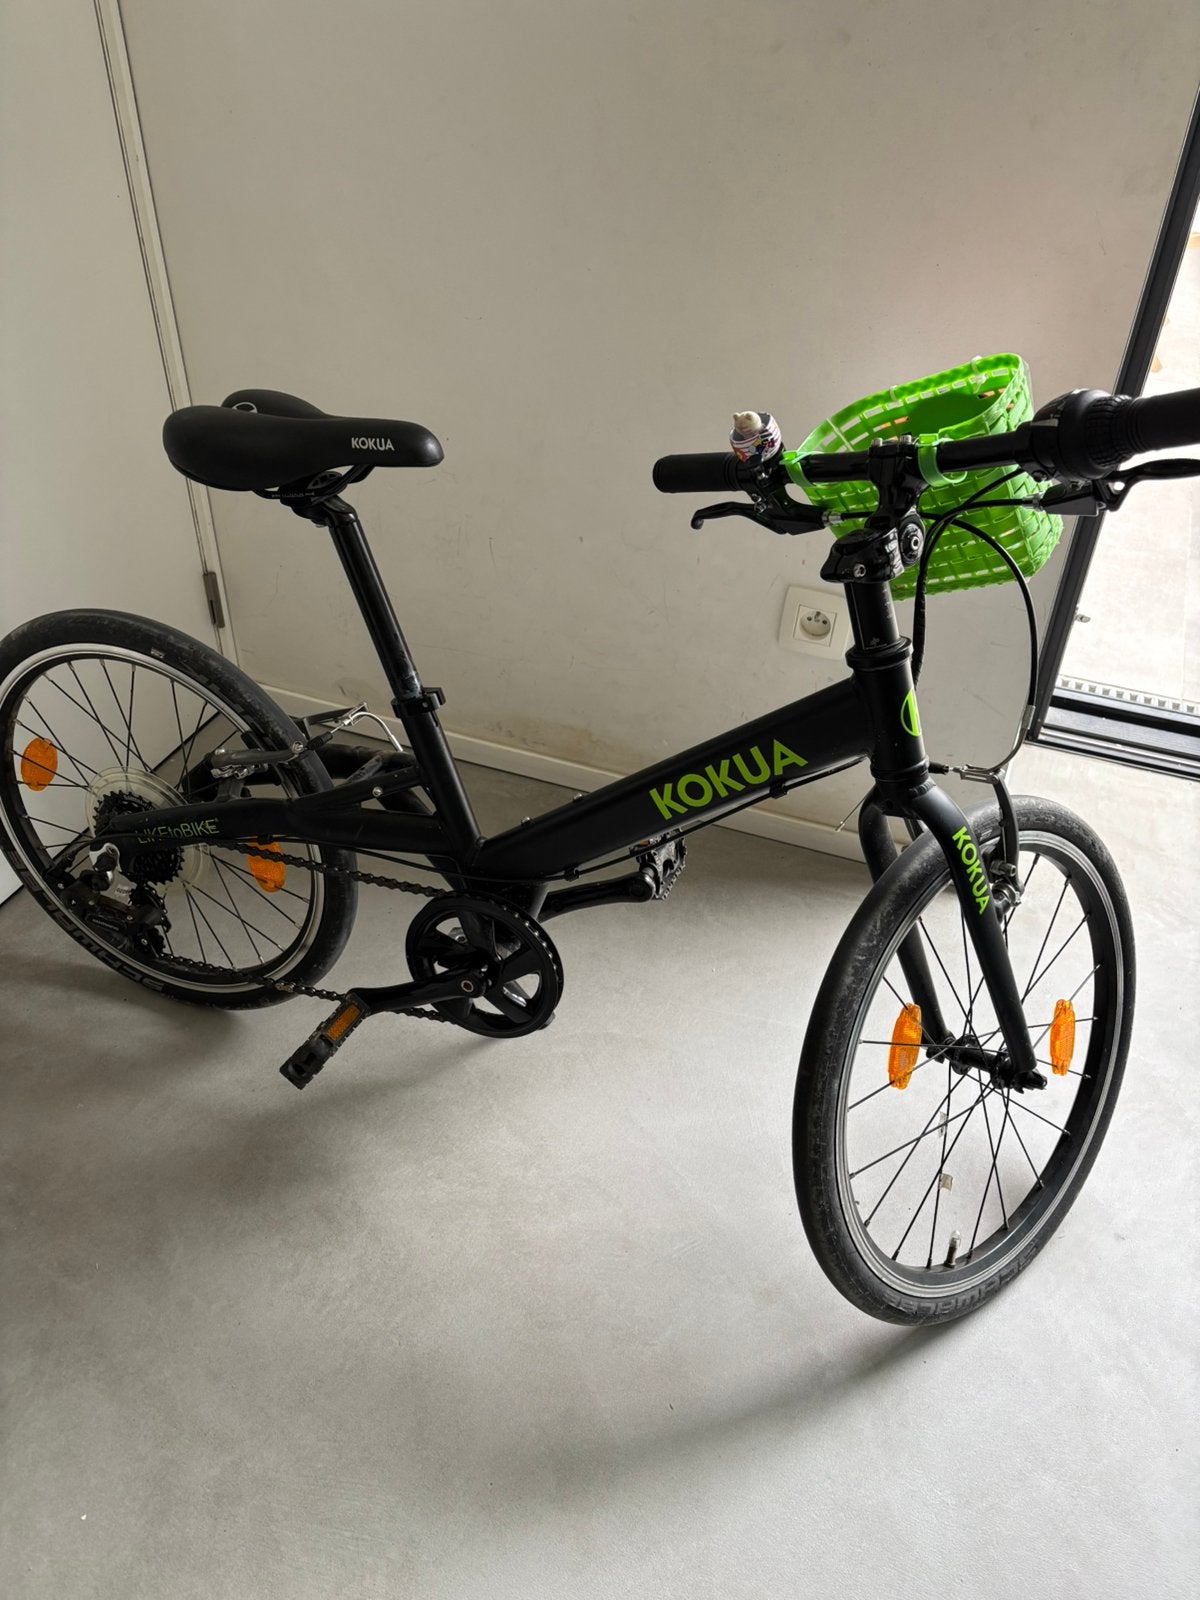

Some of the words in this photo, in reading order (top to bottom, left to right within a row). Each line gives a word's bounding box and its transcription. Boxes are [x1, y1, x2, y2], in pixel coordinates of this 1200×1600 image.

[351, 437, 395, 451] KOKUA
[649, 738, 809, 820] KOKUA
[952, 826, 990, 914] KOKUA
